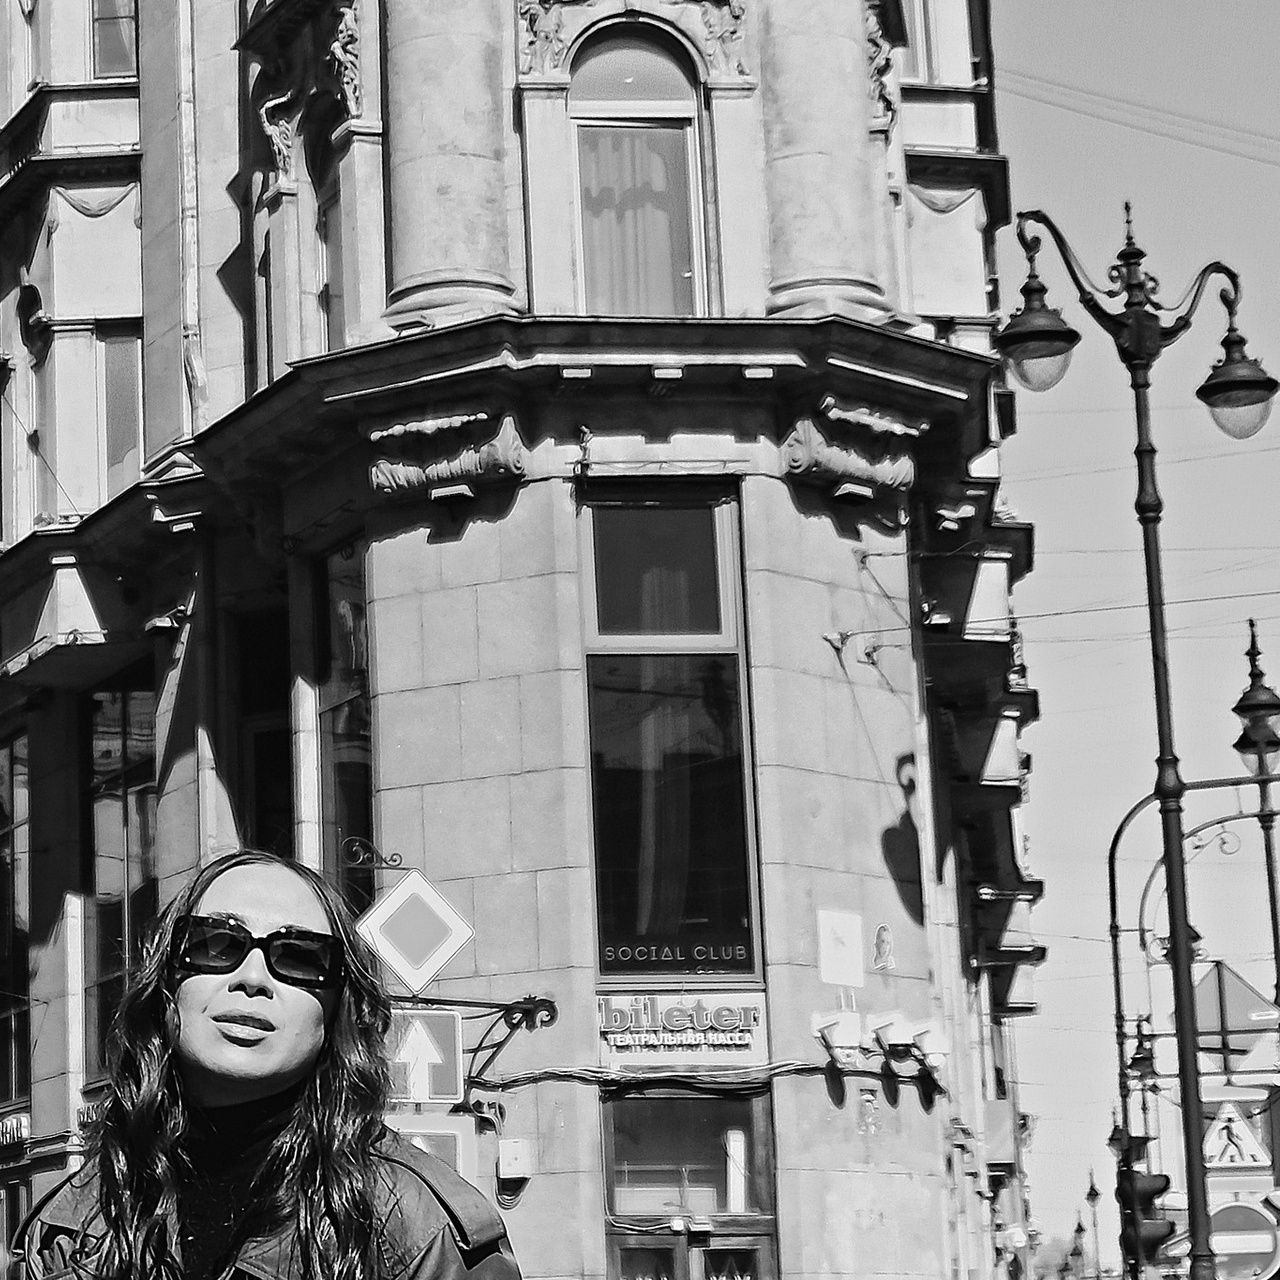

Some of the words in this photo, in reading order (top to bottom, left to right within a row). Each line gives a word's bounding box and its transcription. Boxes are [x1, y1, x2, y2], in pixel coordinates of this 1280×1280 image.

[605, 946, 685, 961] SOCIAL
[694, 945, 747, 960] CLUB
[599, 996, 760, 1031] bileter
[607, 1032, 705, 1046] ТЕАТРАЛЬНАЯ
